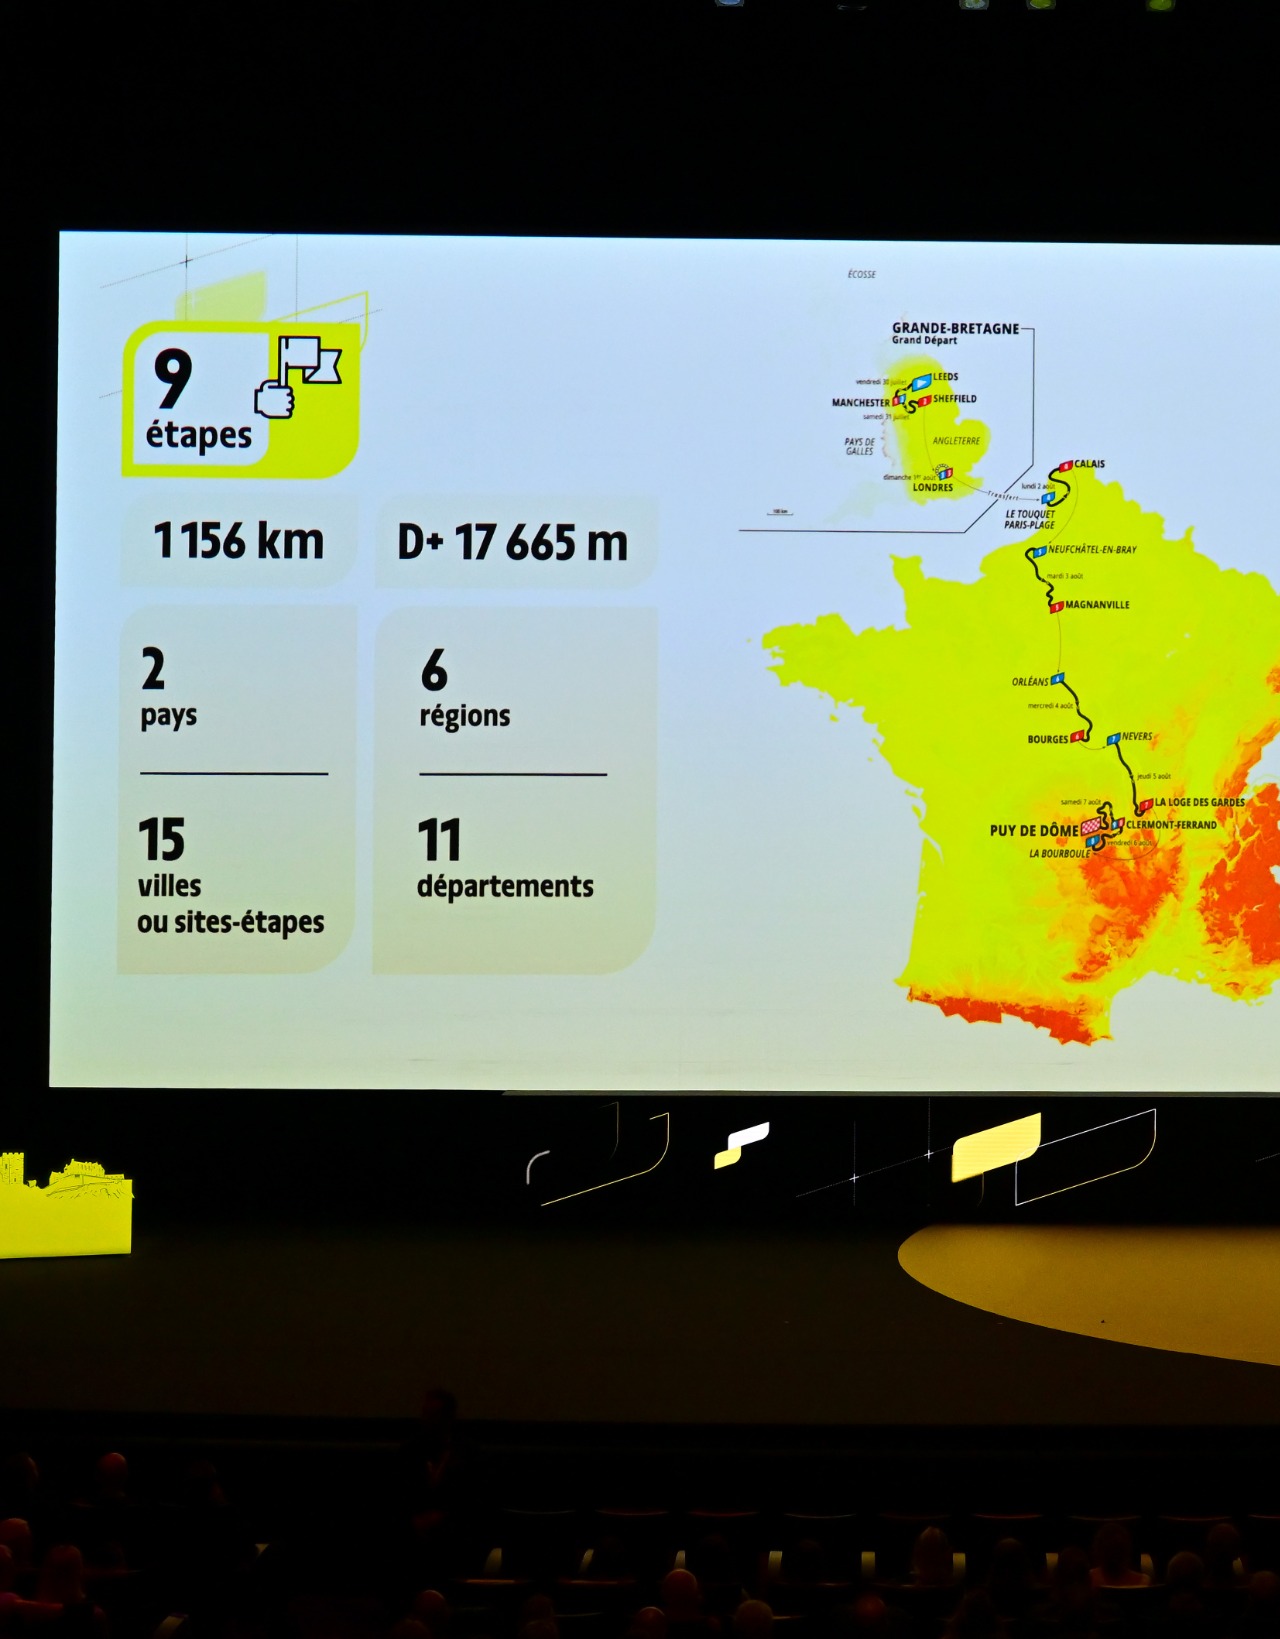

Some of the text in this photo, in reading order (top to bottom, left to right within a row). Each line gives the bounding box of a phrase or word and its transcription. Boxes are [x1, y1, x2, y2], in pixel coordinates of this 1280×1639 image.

[848, 268, 876, 279] ÉCOSSE
[892, 322, 1019, 335] GRANDE-BRETAGNE
[892, 335, 957, 347] Grand Départ
[155, 349, 192, 408] 9
[832, 398, 890, 407] MANCHESTER
[933, 395, 977, 403] SHEFFIELD
[147, 420, 251, 455] étapes
[845, 438, 875, 446] PAYS DE
[933, 437, 981, 445] ANGLETERRE
[846, 447, 874, 455] GALLES
[1075, 460, 1105, 468] CALAIS
[913, 483, 953, 492] LONDRES
[987, 490, 1019, 501] Transfert
[1006, 510, 1056, 520] LE TOUQUET
[1004, 521, 1054, 529] PARIS-PLAGE
[259, 521, 323, 558] km
[399, 523, 627, 560] D+ 17 665 m
[1048, 543, 1137, 554] NEUFCHÂTEL-EN-BRAY
[1066, 600, 1130, 609] MAGNANVILLE
[142, 647, 164, 689] 2
[422, 649, 447, 691] 6
[1012, 676, 1049, 686] ORLÉANS
[142, 708, 196, 732] pays
[421, 704, 510, 733] régions
[1028, 735, 1068, 744] BOURGES
[1122, 732, 1153, 741] NEVERS
[1155, 798, 1245, 807] LA LOGE DES GARDES
[990, 822, 1079, 837] PUY DE DÔME
[1126, 821, 1217, 829] CLERMONT-FERRAND
[139, 817, 184, 861] 15
[419, 818, 459, 861] 11
[1029, 849, 1091, 858] LA BOURBOULE
[139, 874, 201, 897] villes
[418, 874, 593, 903] départements
[138, 910, 324, 940] ou sites-étapes
